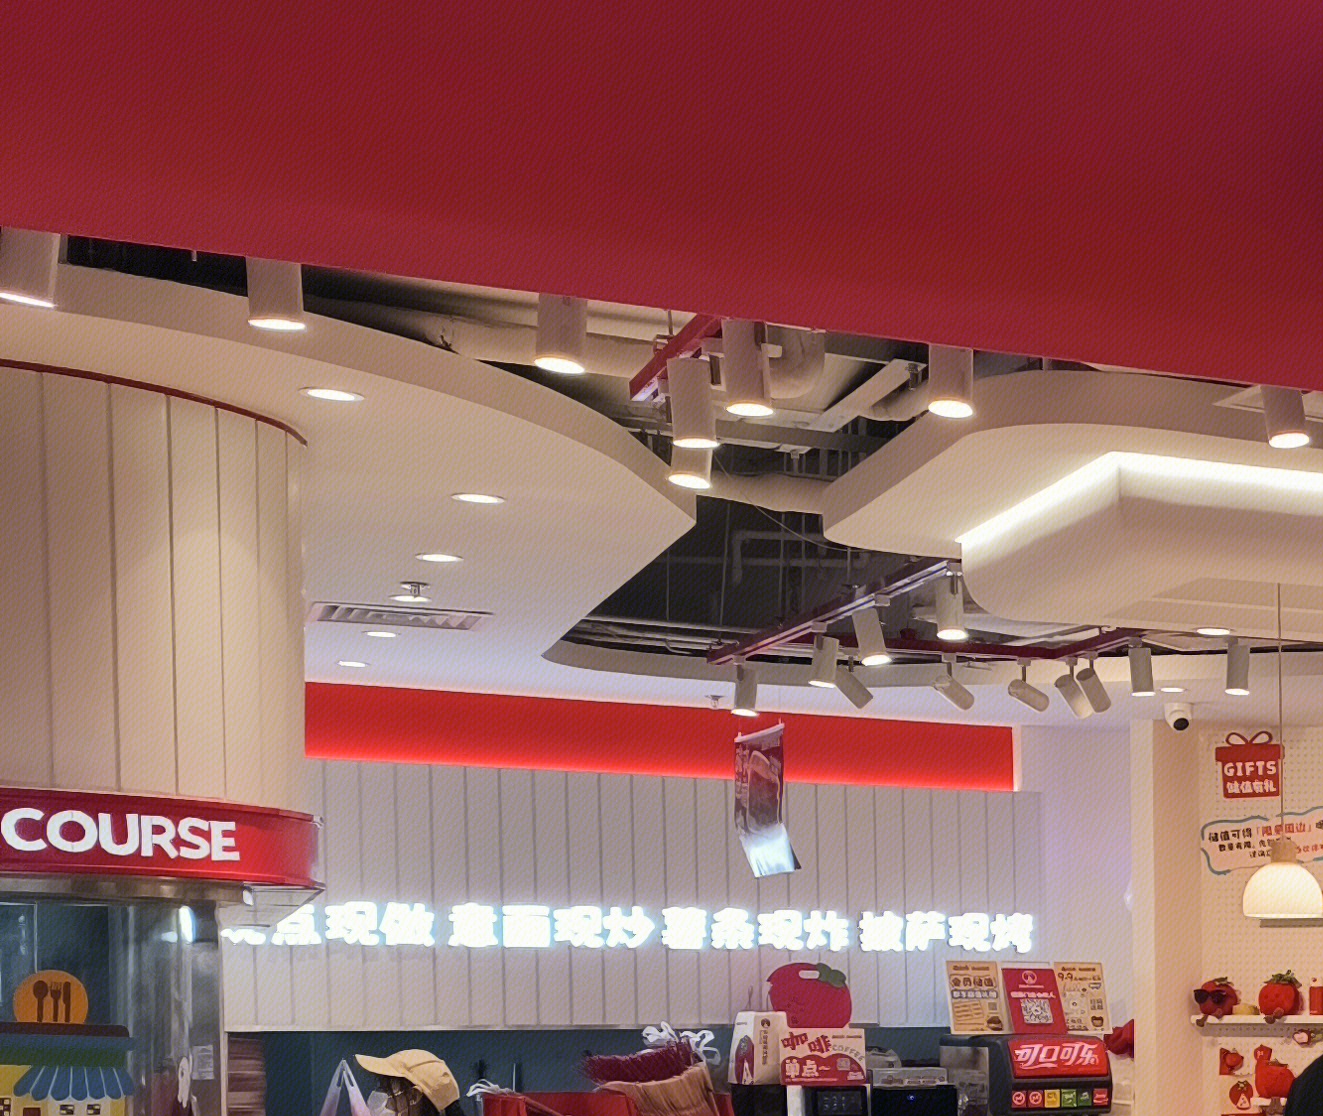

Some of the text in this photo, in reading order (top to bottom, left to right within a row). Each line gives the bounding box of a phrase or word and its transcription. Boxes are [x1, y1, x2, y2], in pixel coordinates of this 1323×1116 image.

[1223, 760, 1277, 777] GIFTS
[0, 808, 241, 862] COURSE
[221, 901, 435, 947] 点现做
[780, 1031, 832, 1054] 咖啡
[1013, 1041, 1100, 1070] 可口可乐
